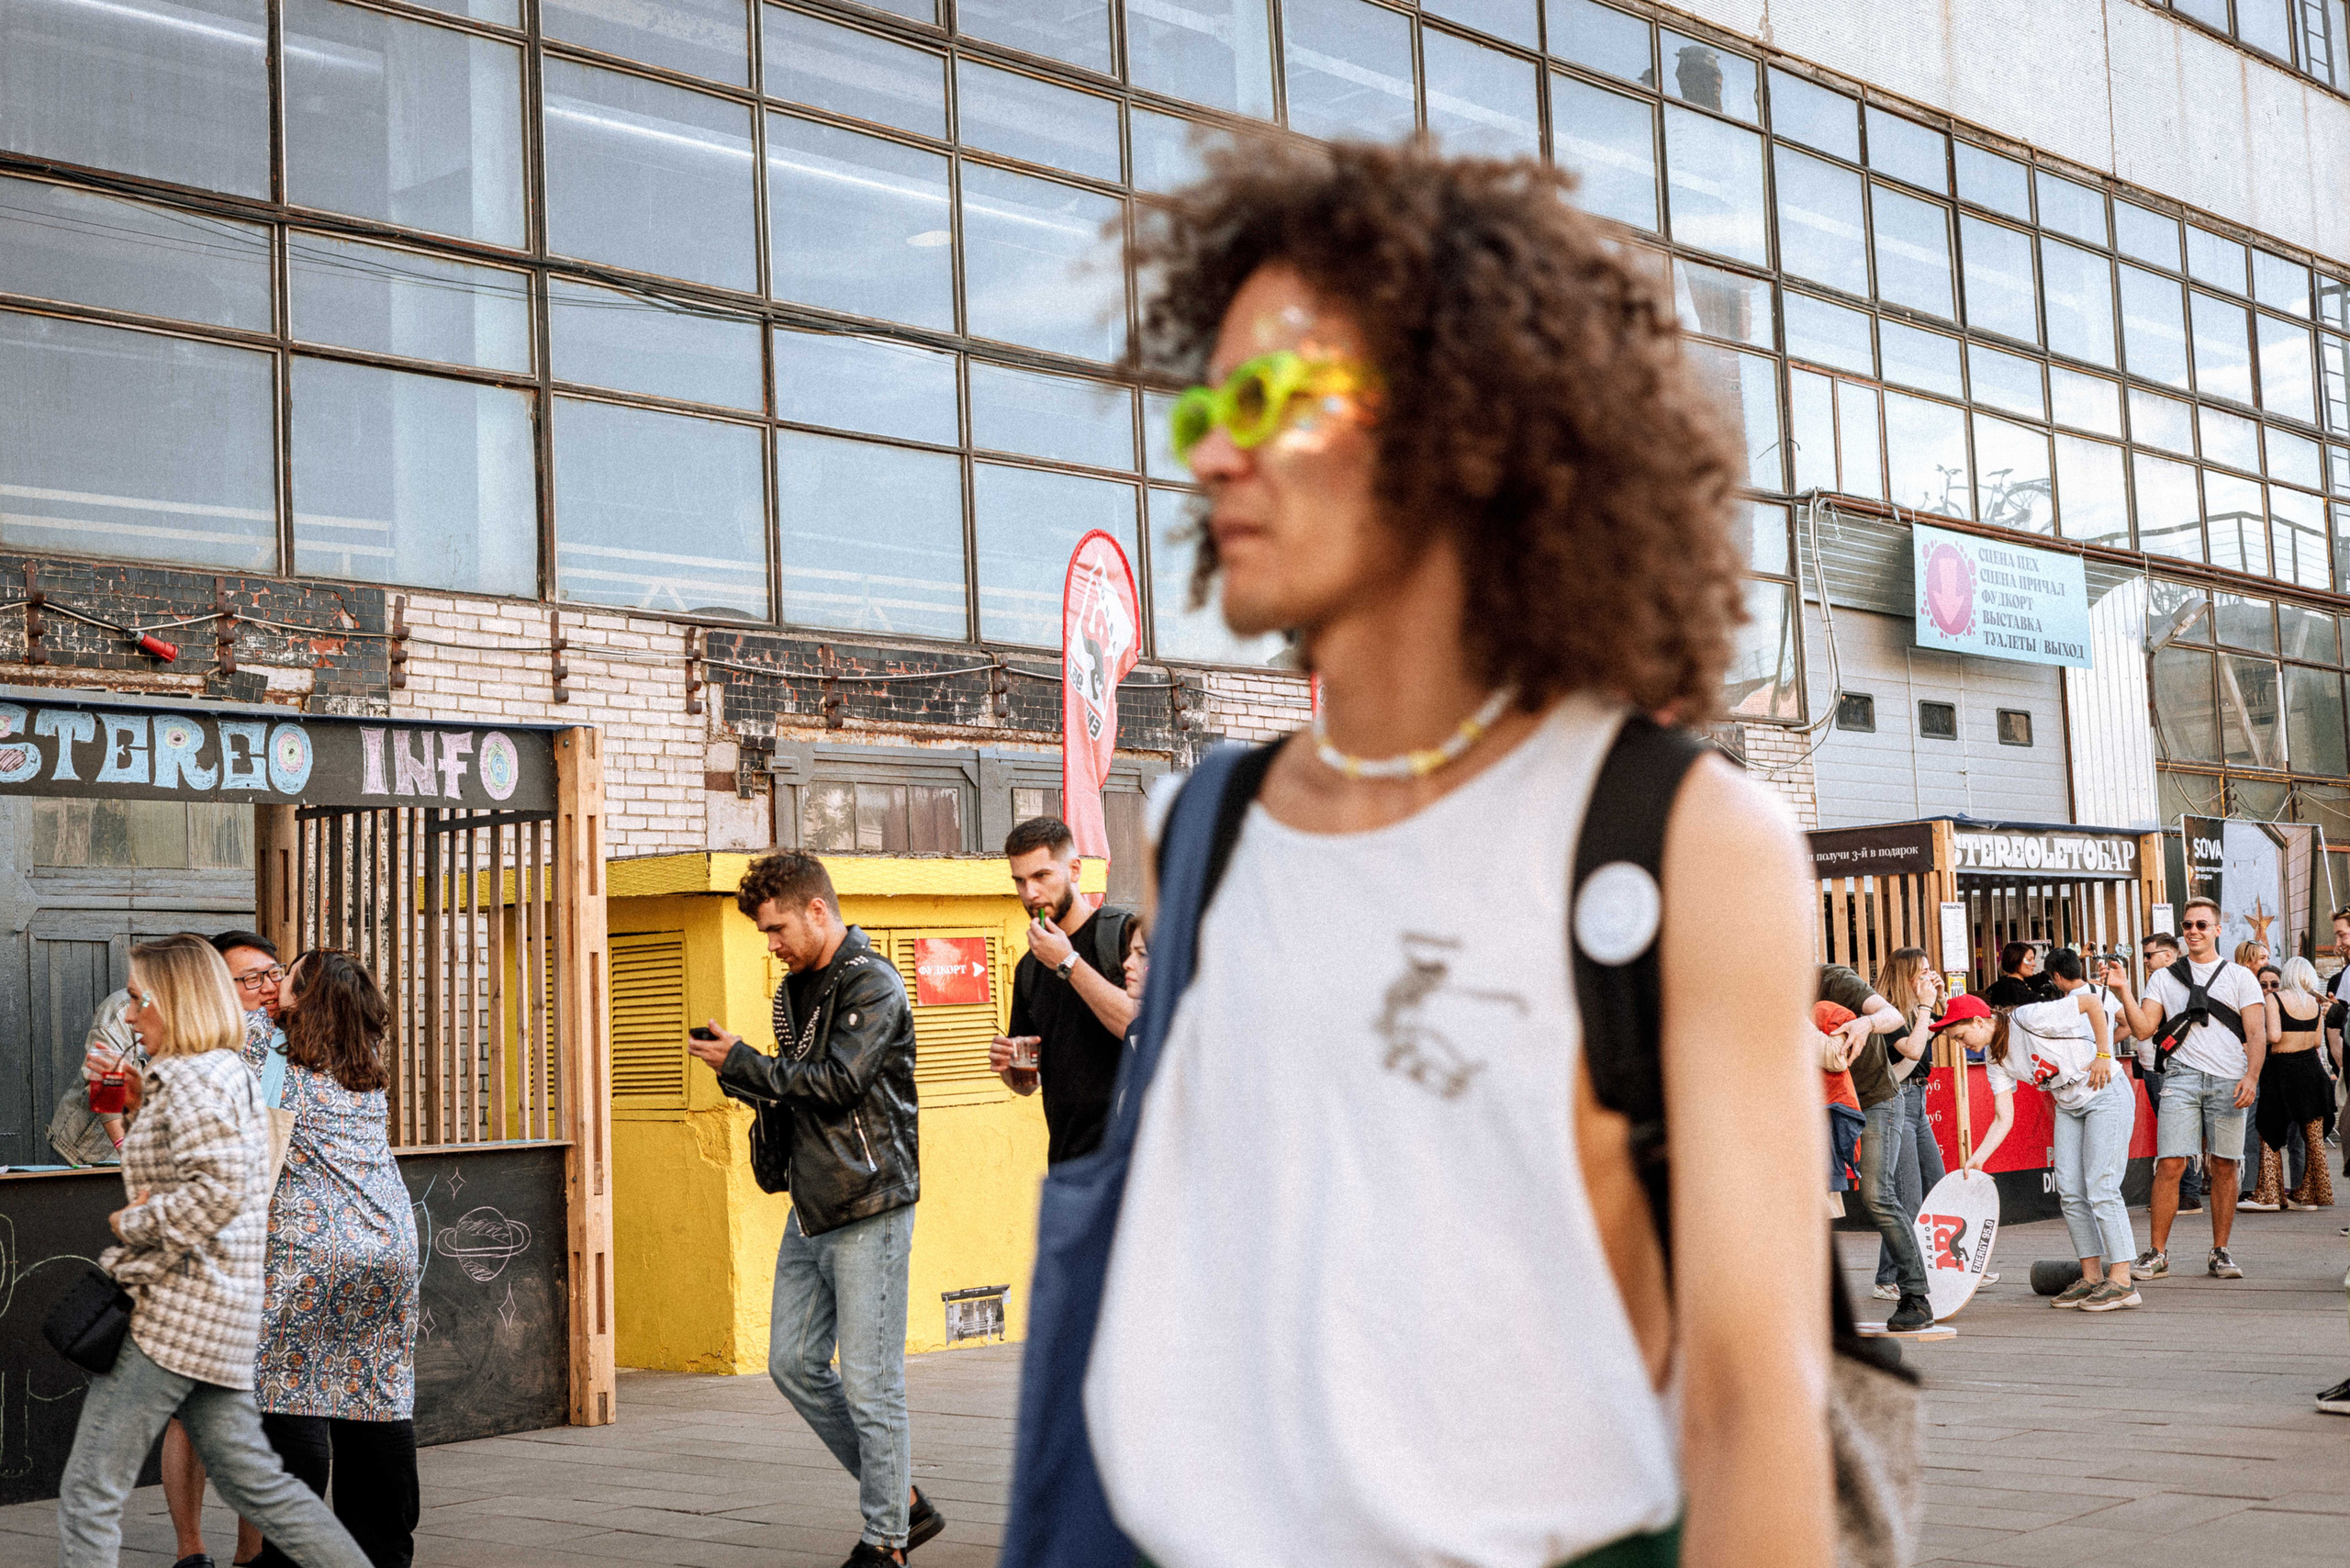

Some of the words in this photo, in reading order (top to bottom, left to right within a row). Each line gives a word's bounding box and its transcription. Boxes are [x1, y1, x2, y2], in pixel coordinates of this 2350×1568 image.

[1979, 547, 2015, 567] СЦЕНА
[2017, 554, 2040, 572] ЦЕХ
[1980, 568, 2017, 588] СЦЕНА
[2019, 575, 2065, 597] ПРИЧАЛ
[1981, 589, 2033, 610] ФУДКОРТ
[1983, 610, 2042, 633] ВЫСТАВКА
[1984, 631, 2036, 652] ТУАЛЕТЫ
[2044, 640, 2085, 659] ВЫХОД
[361, 726, 519, 800] INFO
[1817, 851, 1850, 863] получи
[1852, 847, 1868, 862] 3-й
[1870, 849, 1876, 857] в
[1878, 846, 1919, 859] подарок
[2193, 837, 2223, 860] SOVA
[918, 964, 967, 976] ФУДКОРТ
[1926, 1080, 1941, 1094] уб
[1927, 1110, 1942, 1126] уб
[1924, 1226, 1934, 1270] РАДИО
[1972, 1239, 1989, 1272] ENERGY
[1982, 1219, 1995, 1239] 95.0
